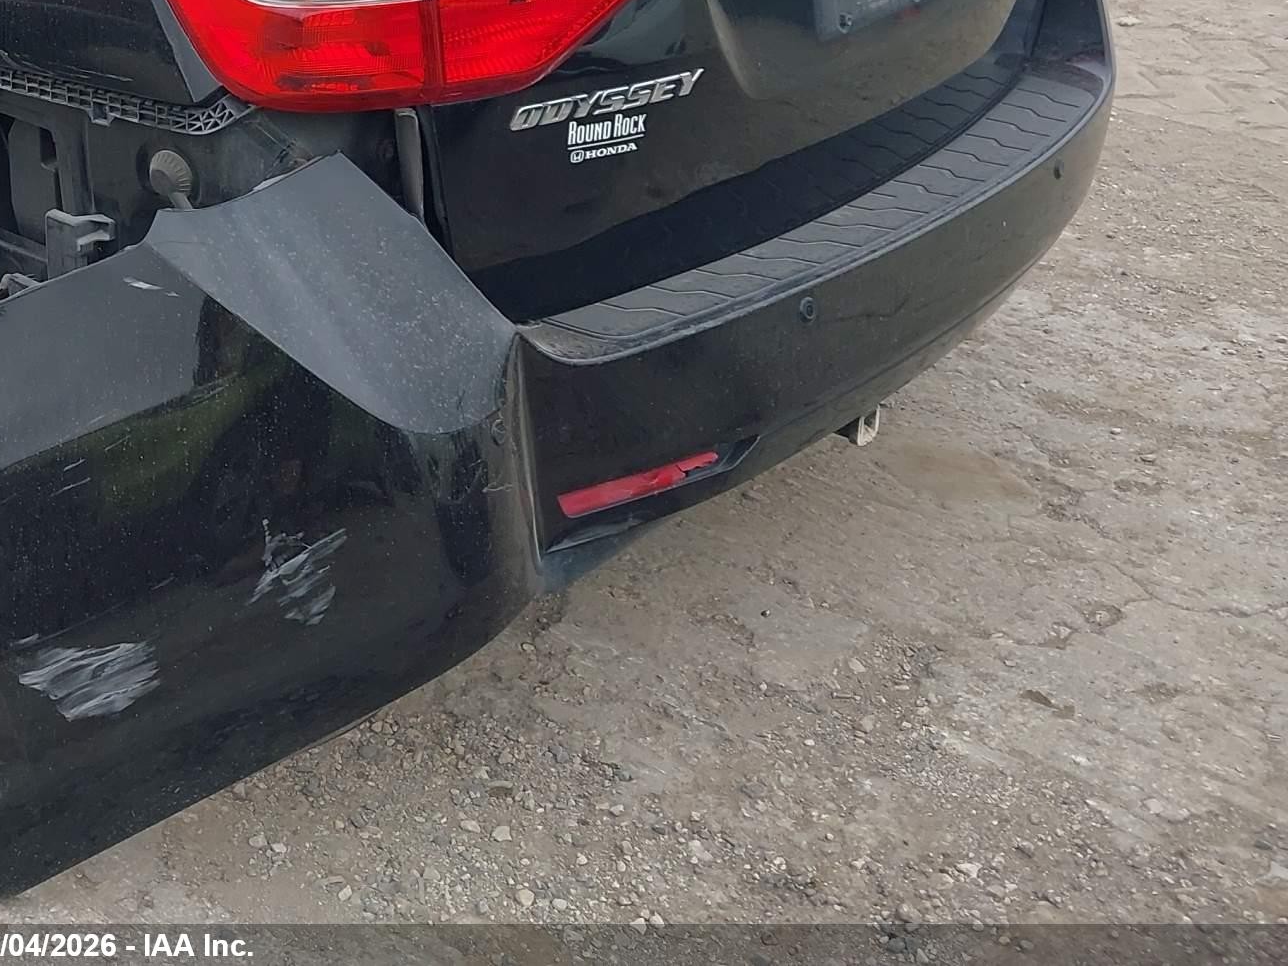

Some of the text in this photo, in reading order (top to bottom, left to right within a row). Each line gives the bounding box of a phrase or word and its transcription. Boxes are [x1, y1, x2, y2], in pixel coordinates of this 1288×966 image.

[509, 68, 705, 132] ODYSSEY
[567, 113, 648, 146] ROUND ROCK
[584, 142, 638, 160] HONDA
